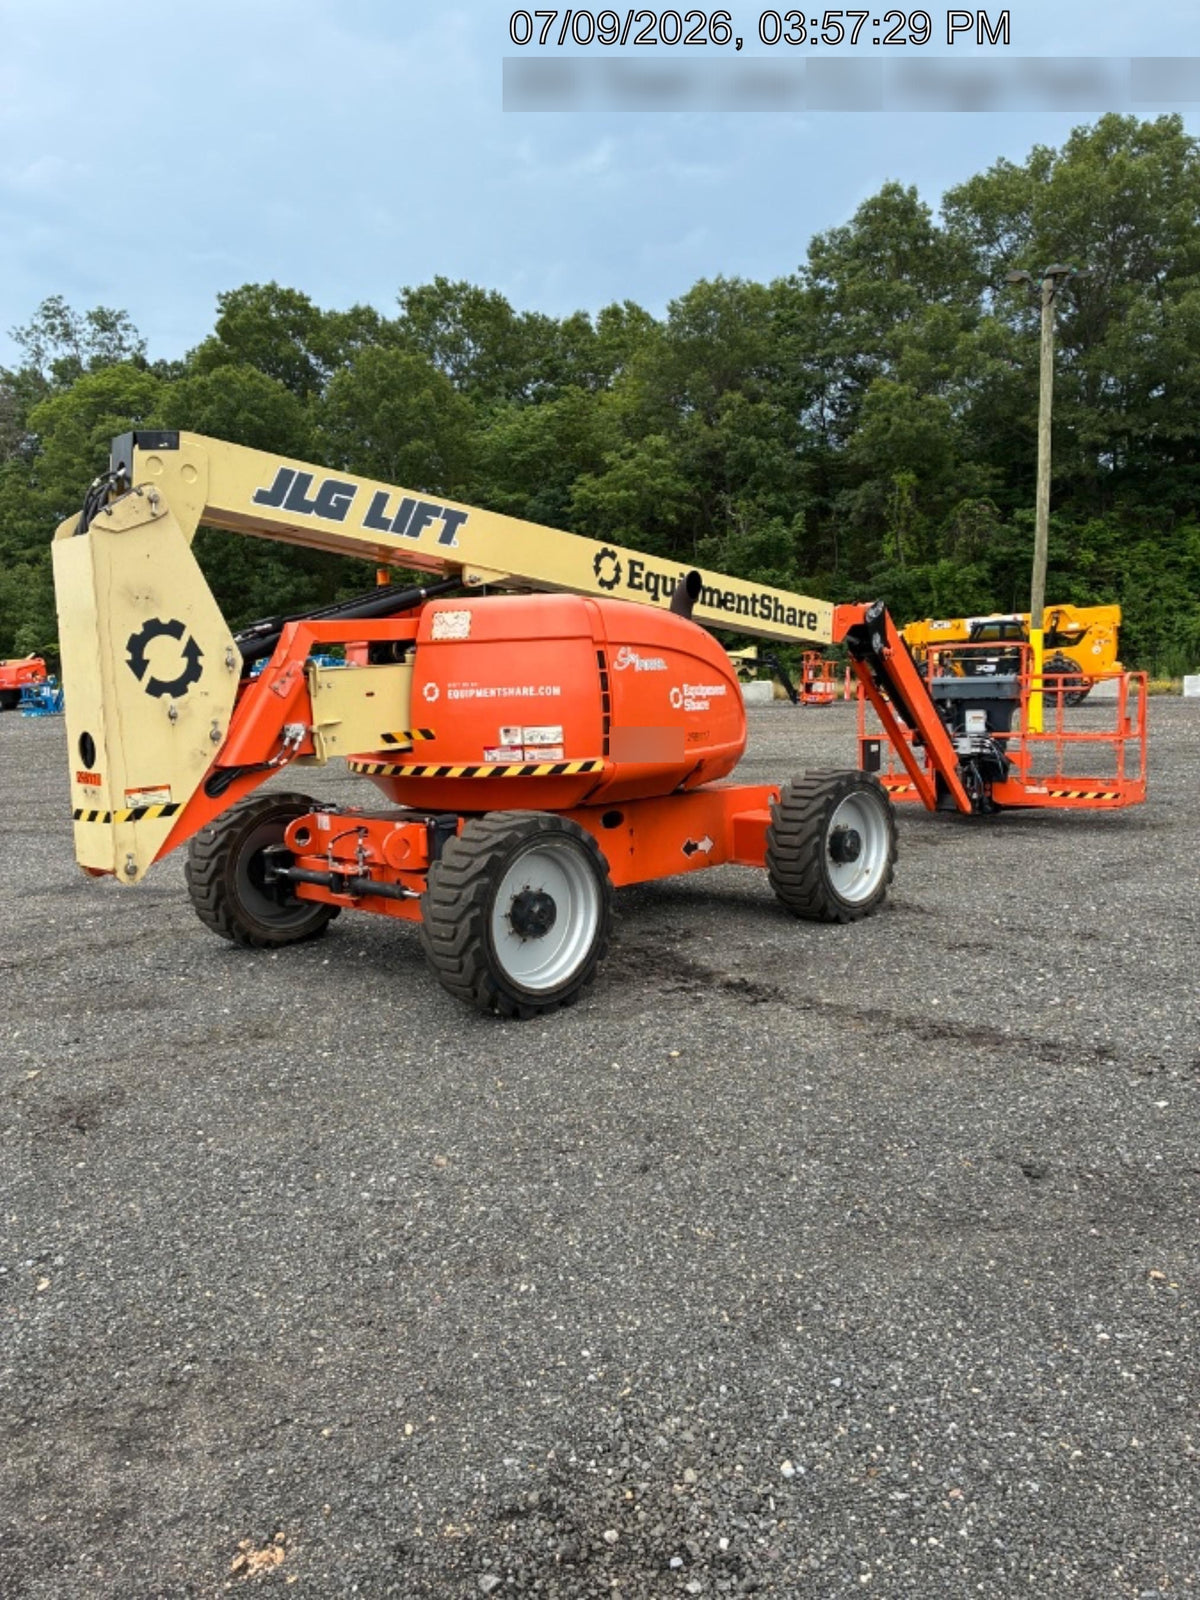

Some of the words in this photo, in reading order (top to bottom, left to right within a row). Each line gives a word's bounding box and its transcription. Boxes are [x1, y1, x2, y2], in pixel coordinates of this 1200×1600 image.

[252, 466, 358, 522] JLG
[362, 490, 469, 546] LIFT
[626, 558, 818, 632] EqumentShare
[447, 685, 561, 700] EQUIPMENTSHARE.COM
